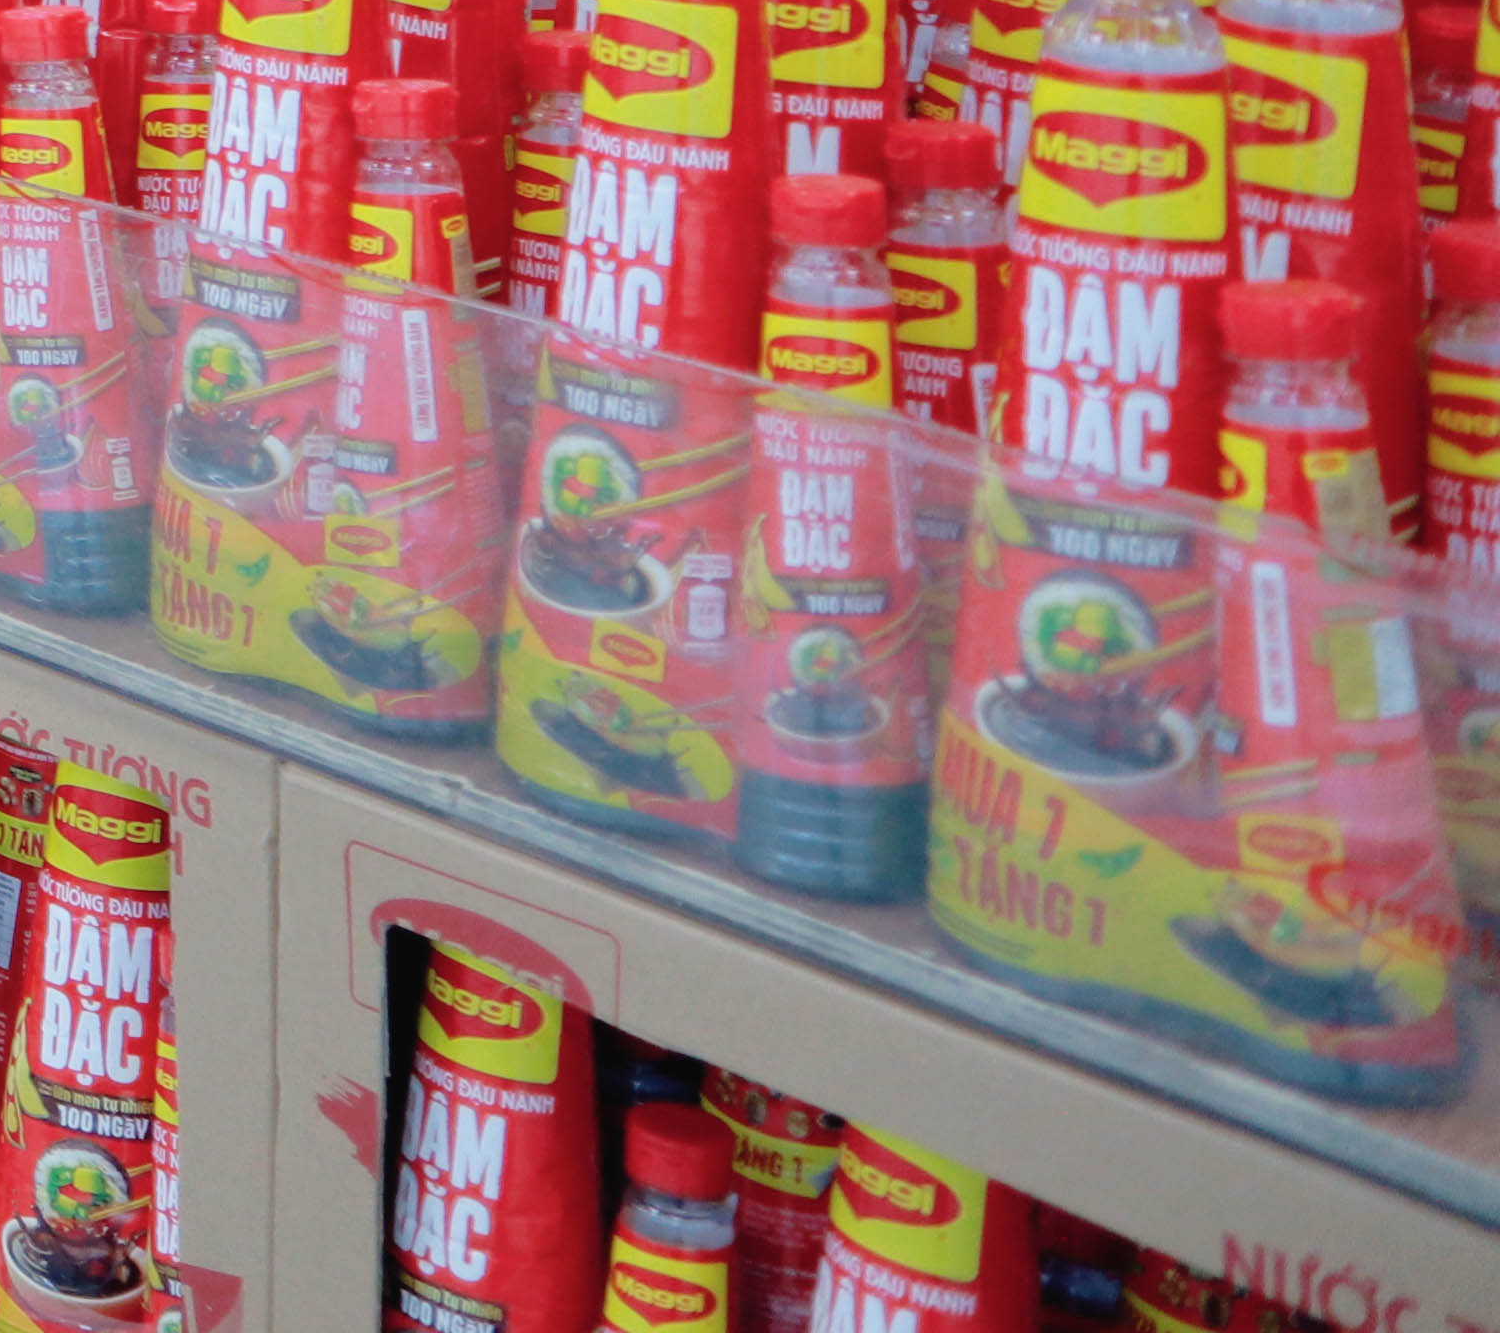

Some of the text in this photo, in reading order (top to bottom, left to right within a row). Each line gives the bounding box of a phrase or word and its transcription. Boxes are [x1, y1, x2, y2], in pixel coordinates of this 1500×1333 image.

[1032, 127, 1190, 182] Maggi
[1022, 262, 1182, 390] ĐẬM
[1020, 379, 1172, 496] ĐẶC
[55, 799, 162, 847] Maggi
[955, 836, 1076, 937] TẶNG
[42, 902, 152, 1004] ĐẬM
[39, 992, 145, 1090] ĐẶC
[56, 1103, 93, 1134] 100
